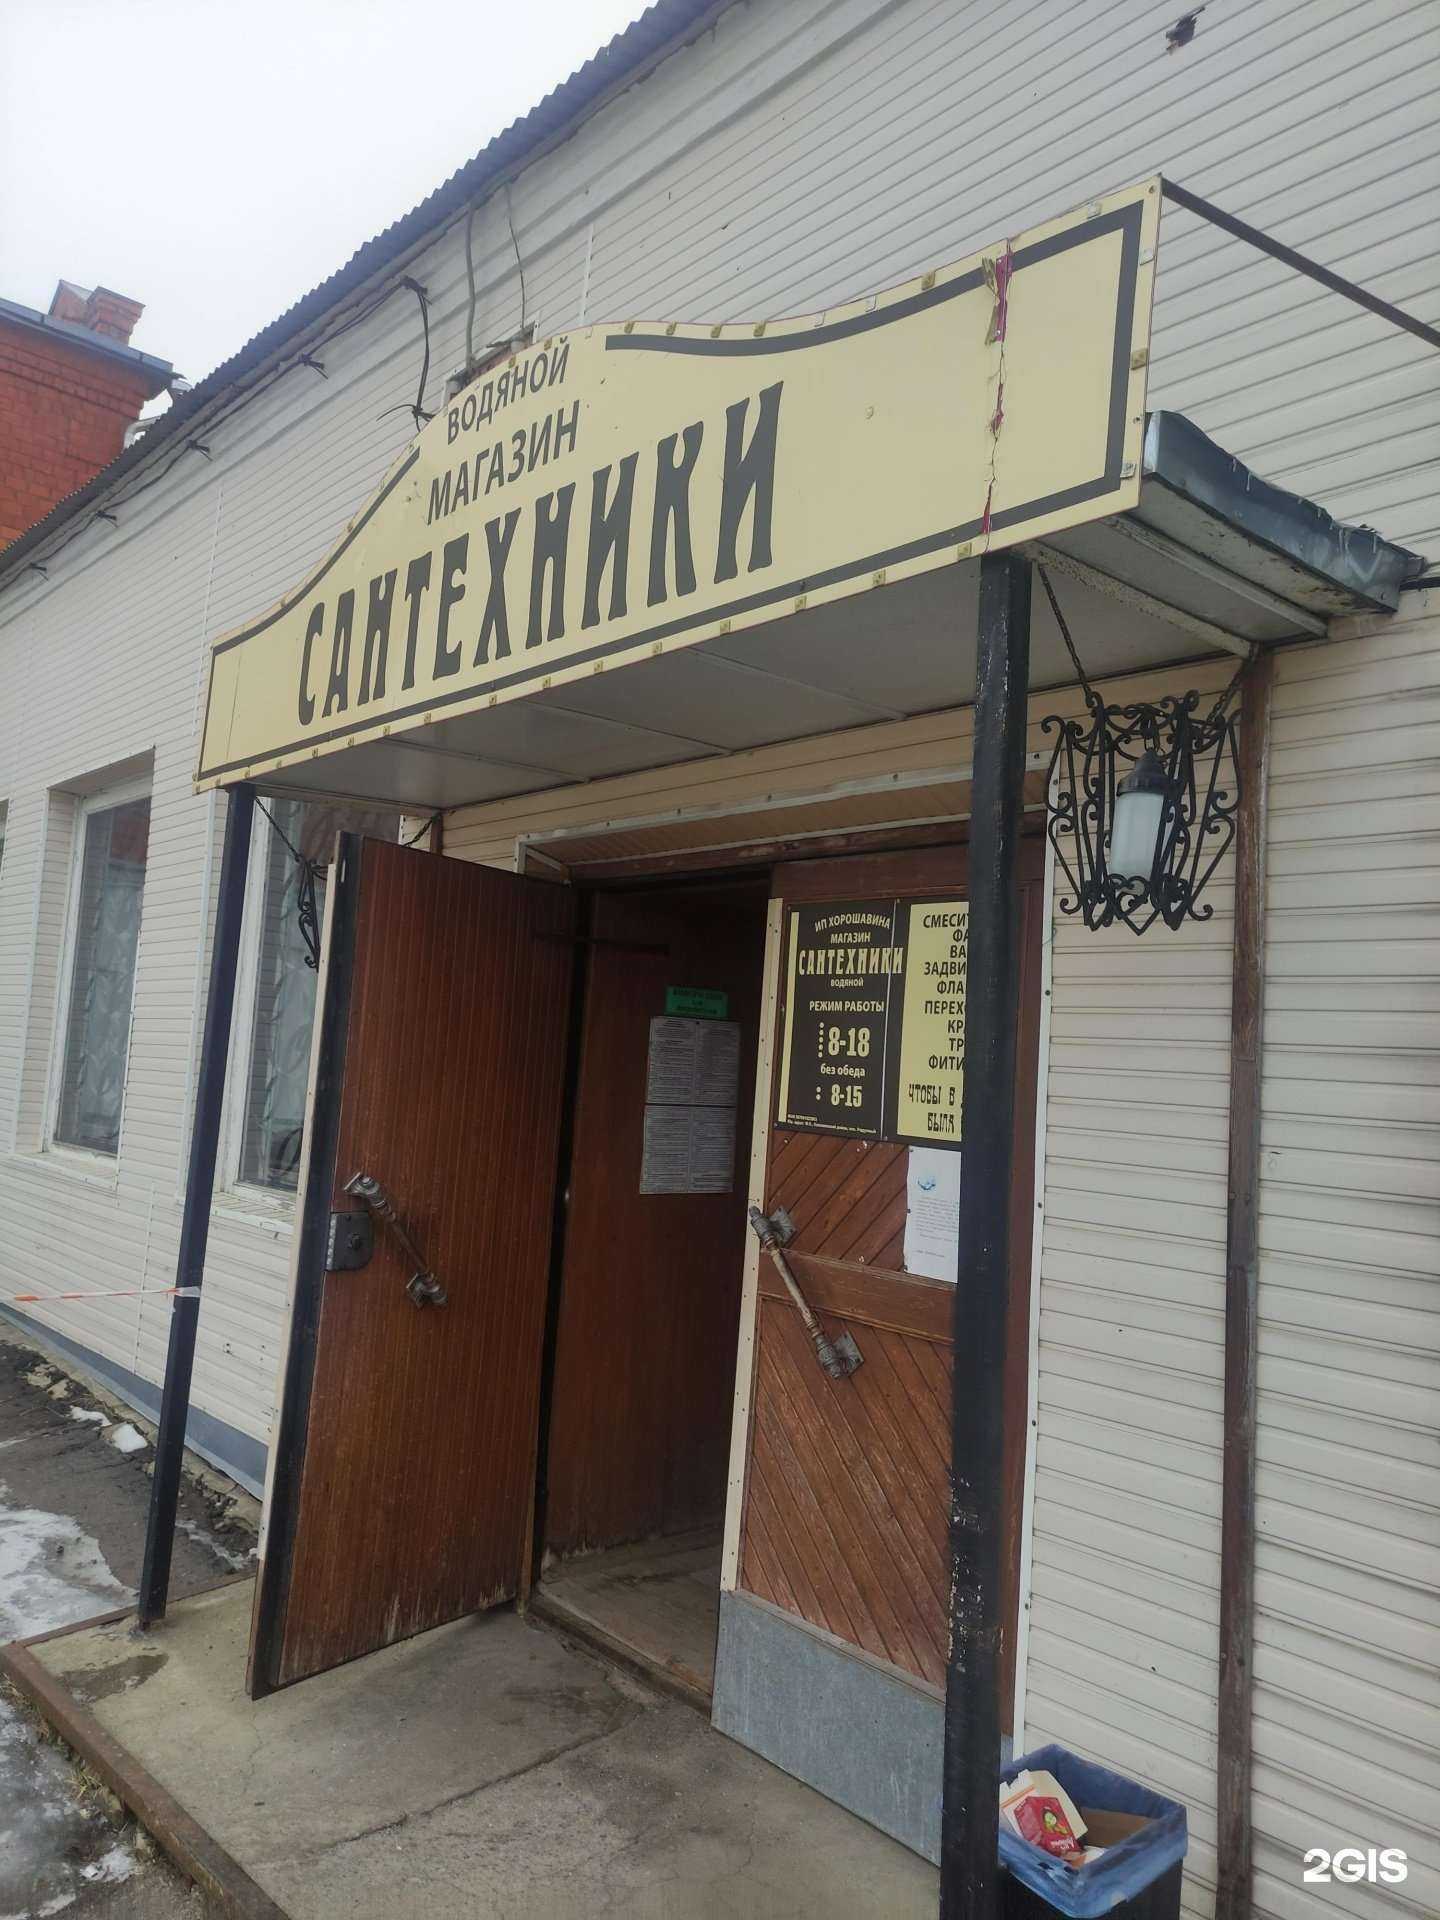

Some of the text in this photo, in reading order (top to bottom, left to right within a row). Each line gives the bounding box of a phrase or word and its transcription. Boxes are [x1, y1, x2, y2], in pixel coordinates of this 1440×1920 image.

[447, 337, 570, 445] ВОДЯНОЙ
[427, 400, 581, 526] МАГАЗИН
[298, 380, 785, 726] САНТЕХНИКИ
[815, 913, 891, 932] ИП ХОРОШАВИНА
[831, 931, 871, 944] МАГАЗИН
[799, 947, 903, 976] САНТЕХНИКИ
[809, 1000, 884, 1012] РЕЖИМ РАБОТЫ
[925, 1000, 965, 1015] ПЕРЕХ
[947, 1019, 965, 1034] КР
[828, 1026, 871, 1057] 8-18
[820, 1063, 866, 1077] без обеда
[831, 1084, 863, 1107] 8-15
[909, 1083, 956, 1107] ЧТОБЫ В
